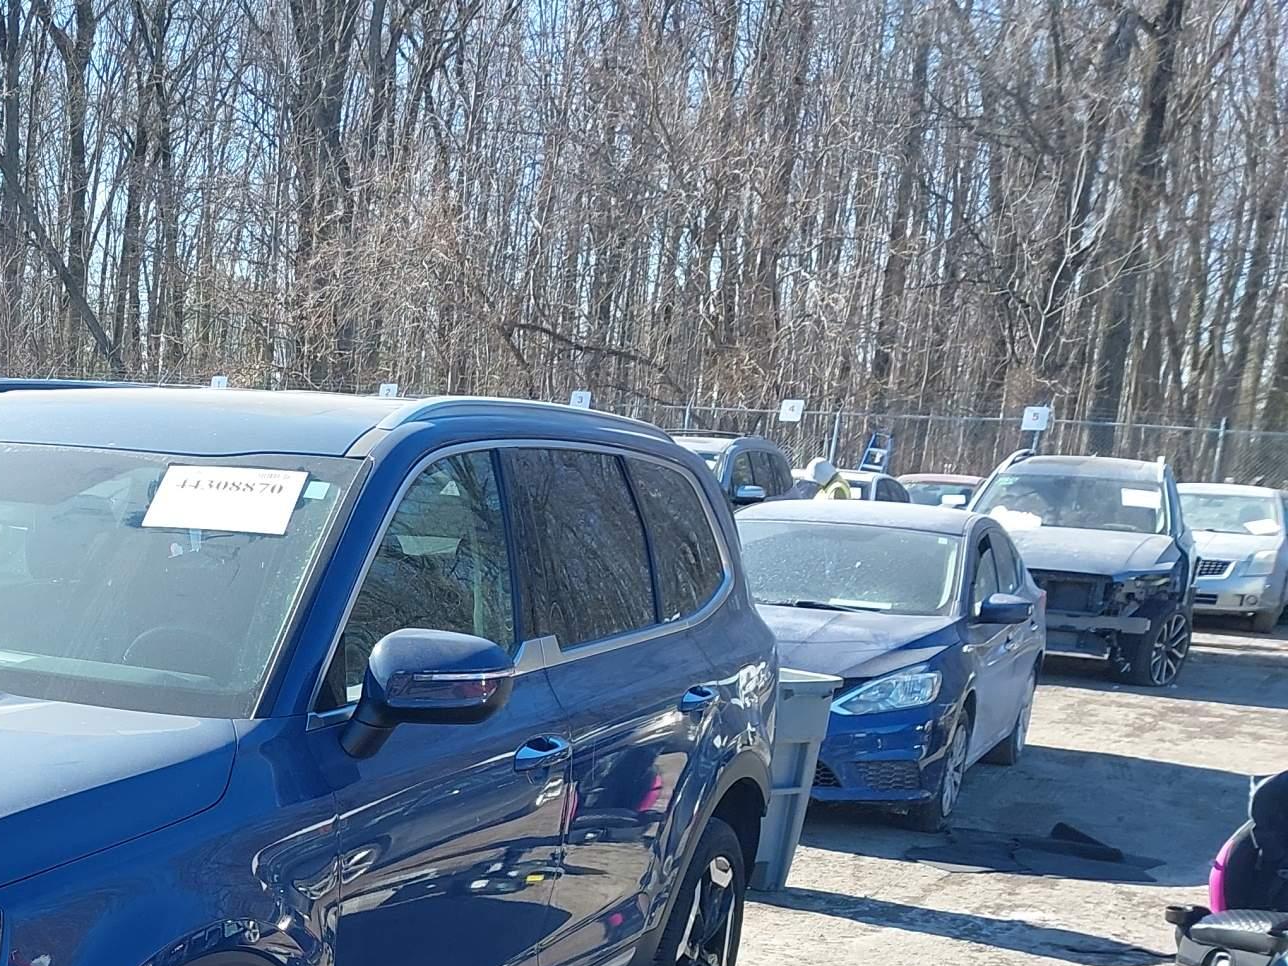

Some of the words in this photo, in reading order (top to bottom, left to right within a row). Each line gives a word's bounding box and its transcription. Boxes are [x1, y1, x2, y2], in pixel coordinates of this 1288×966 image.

[385, 388, 391, 396] 2
[577, 395, 584, 404] 3
[788, 405, 796, 413] 4
[1032, 412, 1039, 421] 5
[176, 478, 284, 495] 44308870
